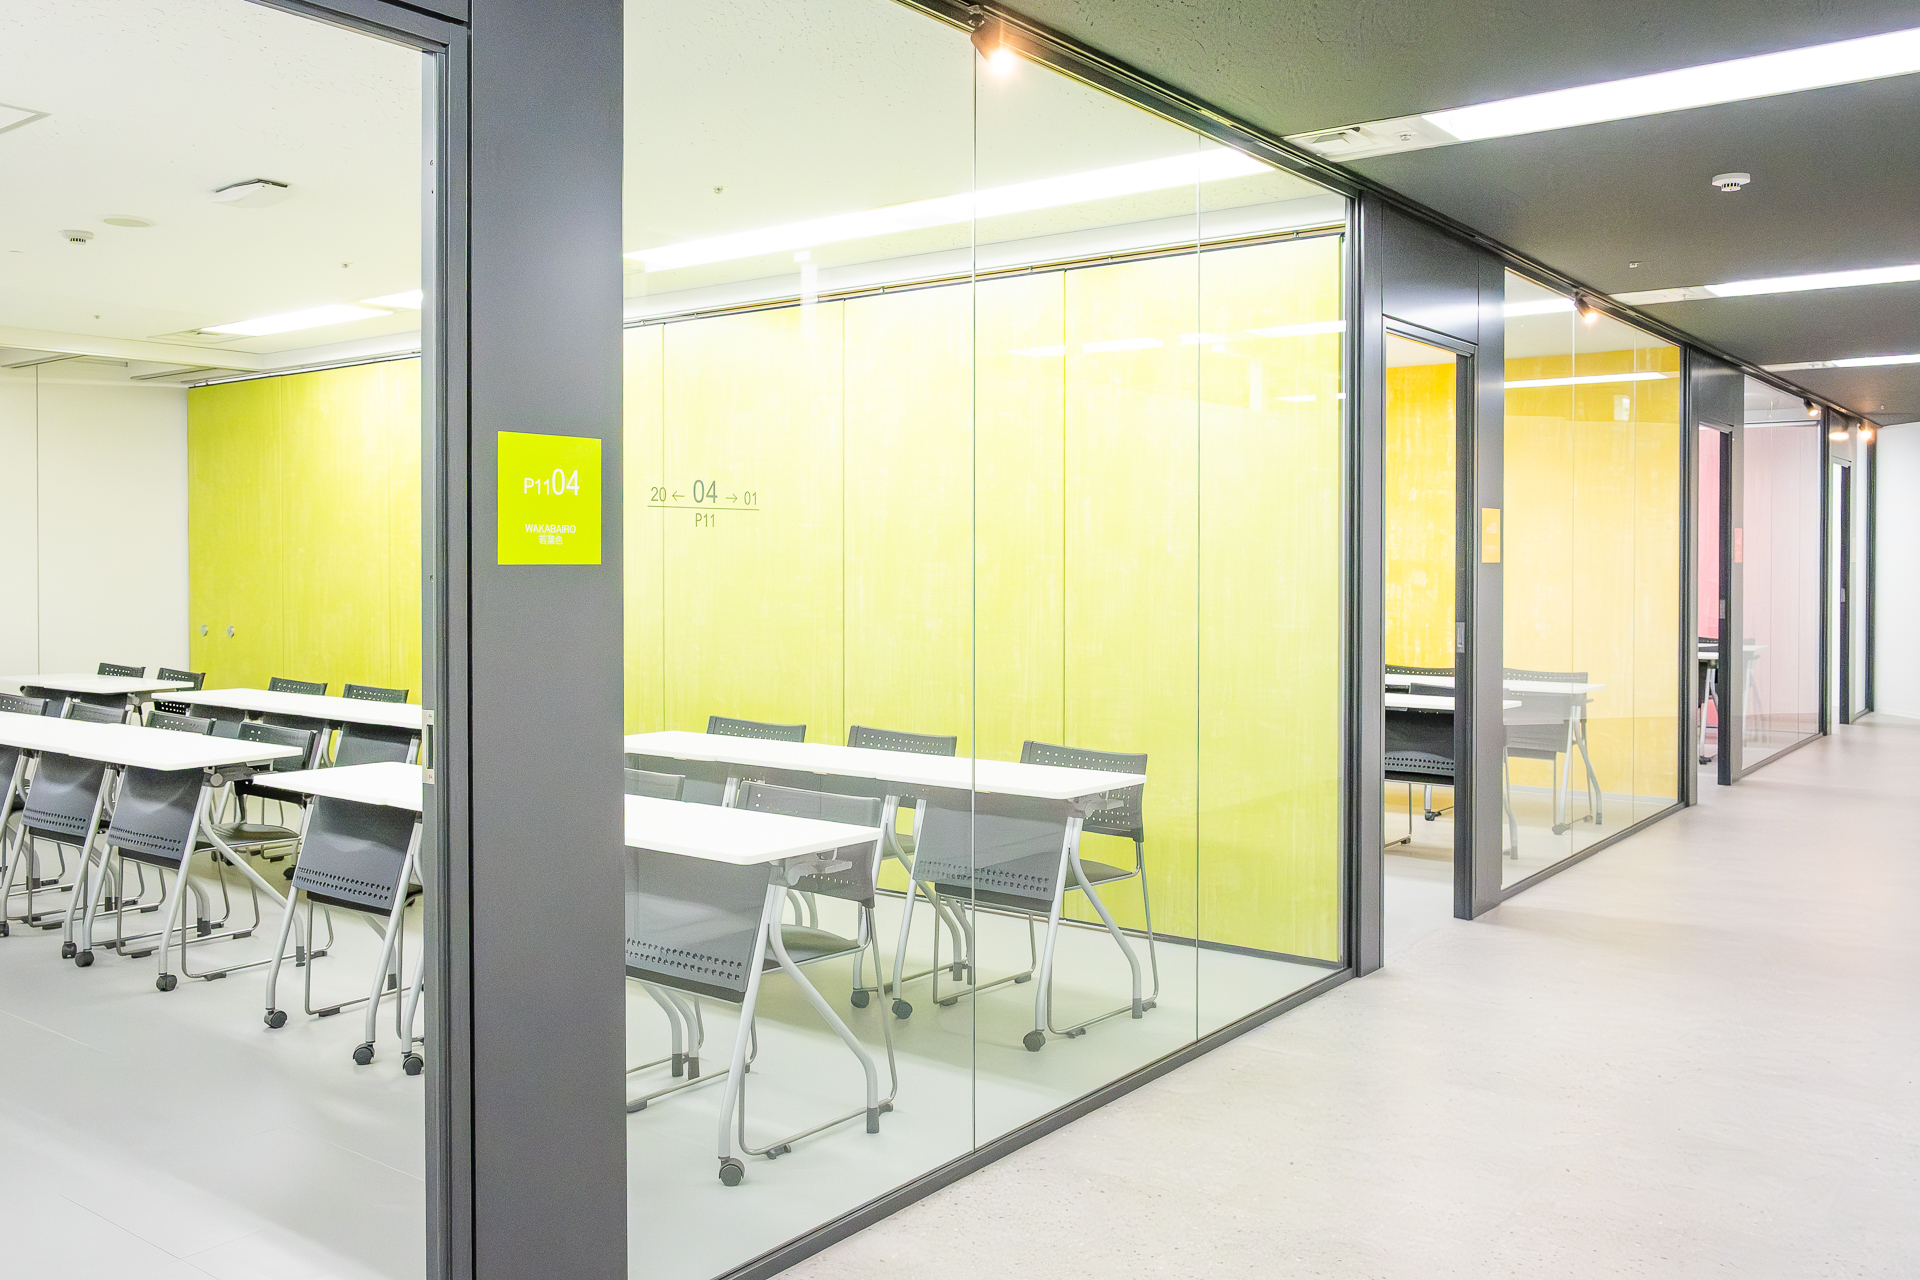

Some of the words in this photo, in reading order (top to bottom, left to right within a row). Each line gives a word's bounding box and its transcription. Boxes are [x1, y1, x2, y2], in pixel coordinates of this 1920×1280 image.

[524, 468, 580, 496] P1104
[651, 487, 667, 502] 20
[693, 479, 718, 503] 04
[744, 491, 757, 505] 01
[524, 524, 577, 534] WAKABAIRO
[695, 513, 715, 527] P11
